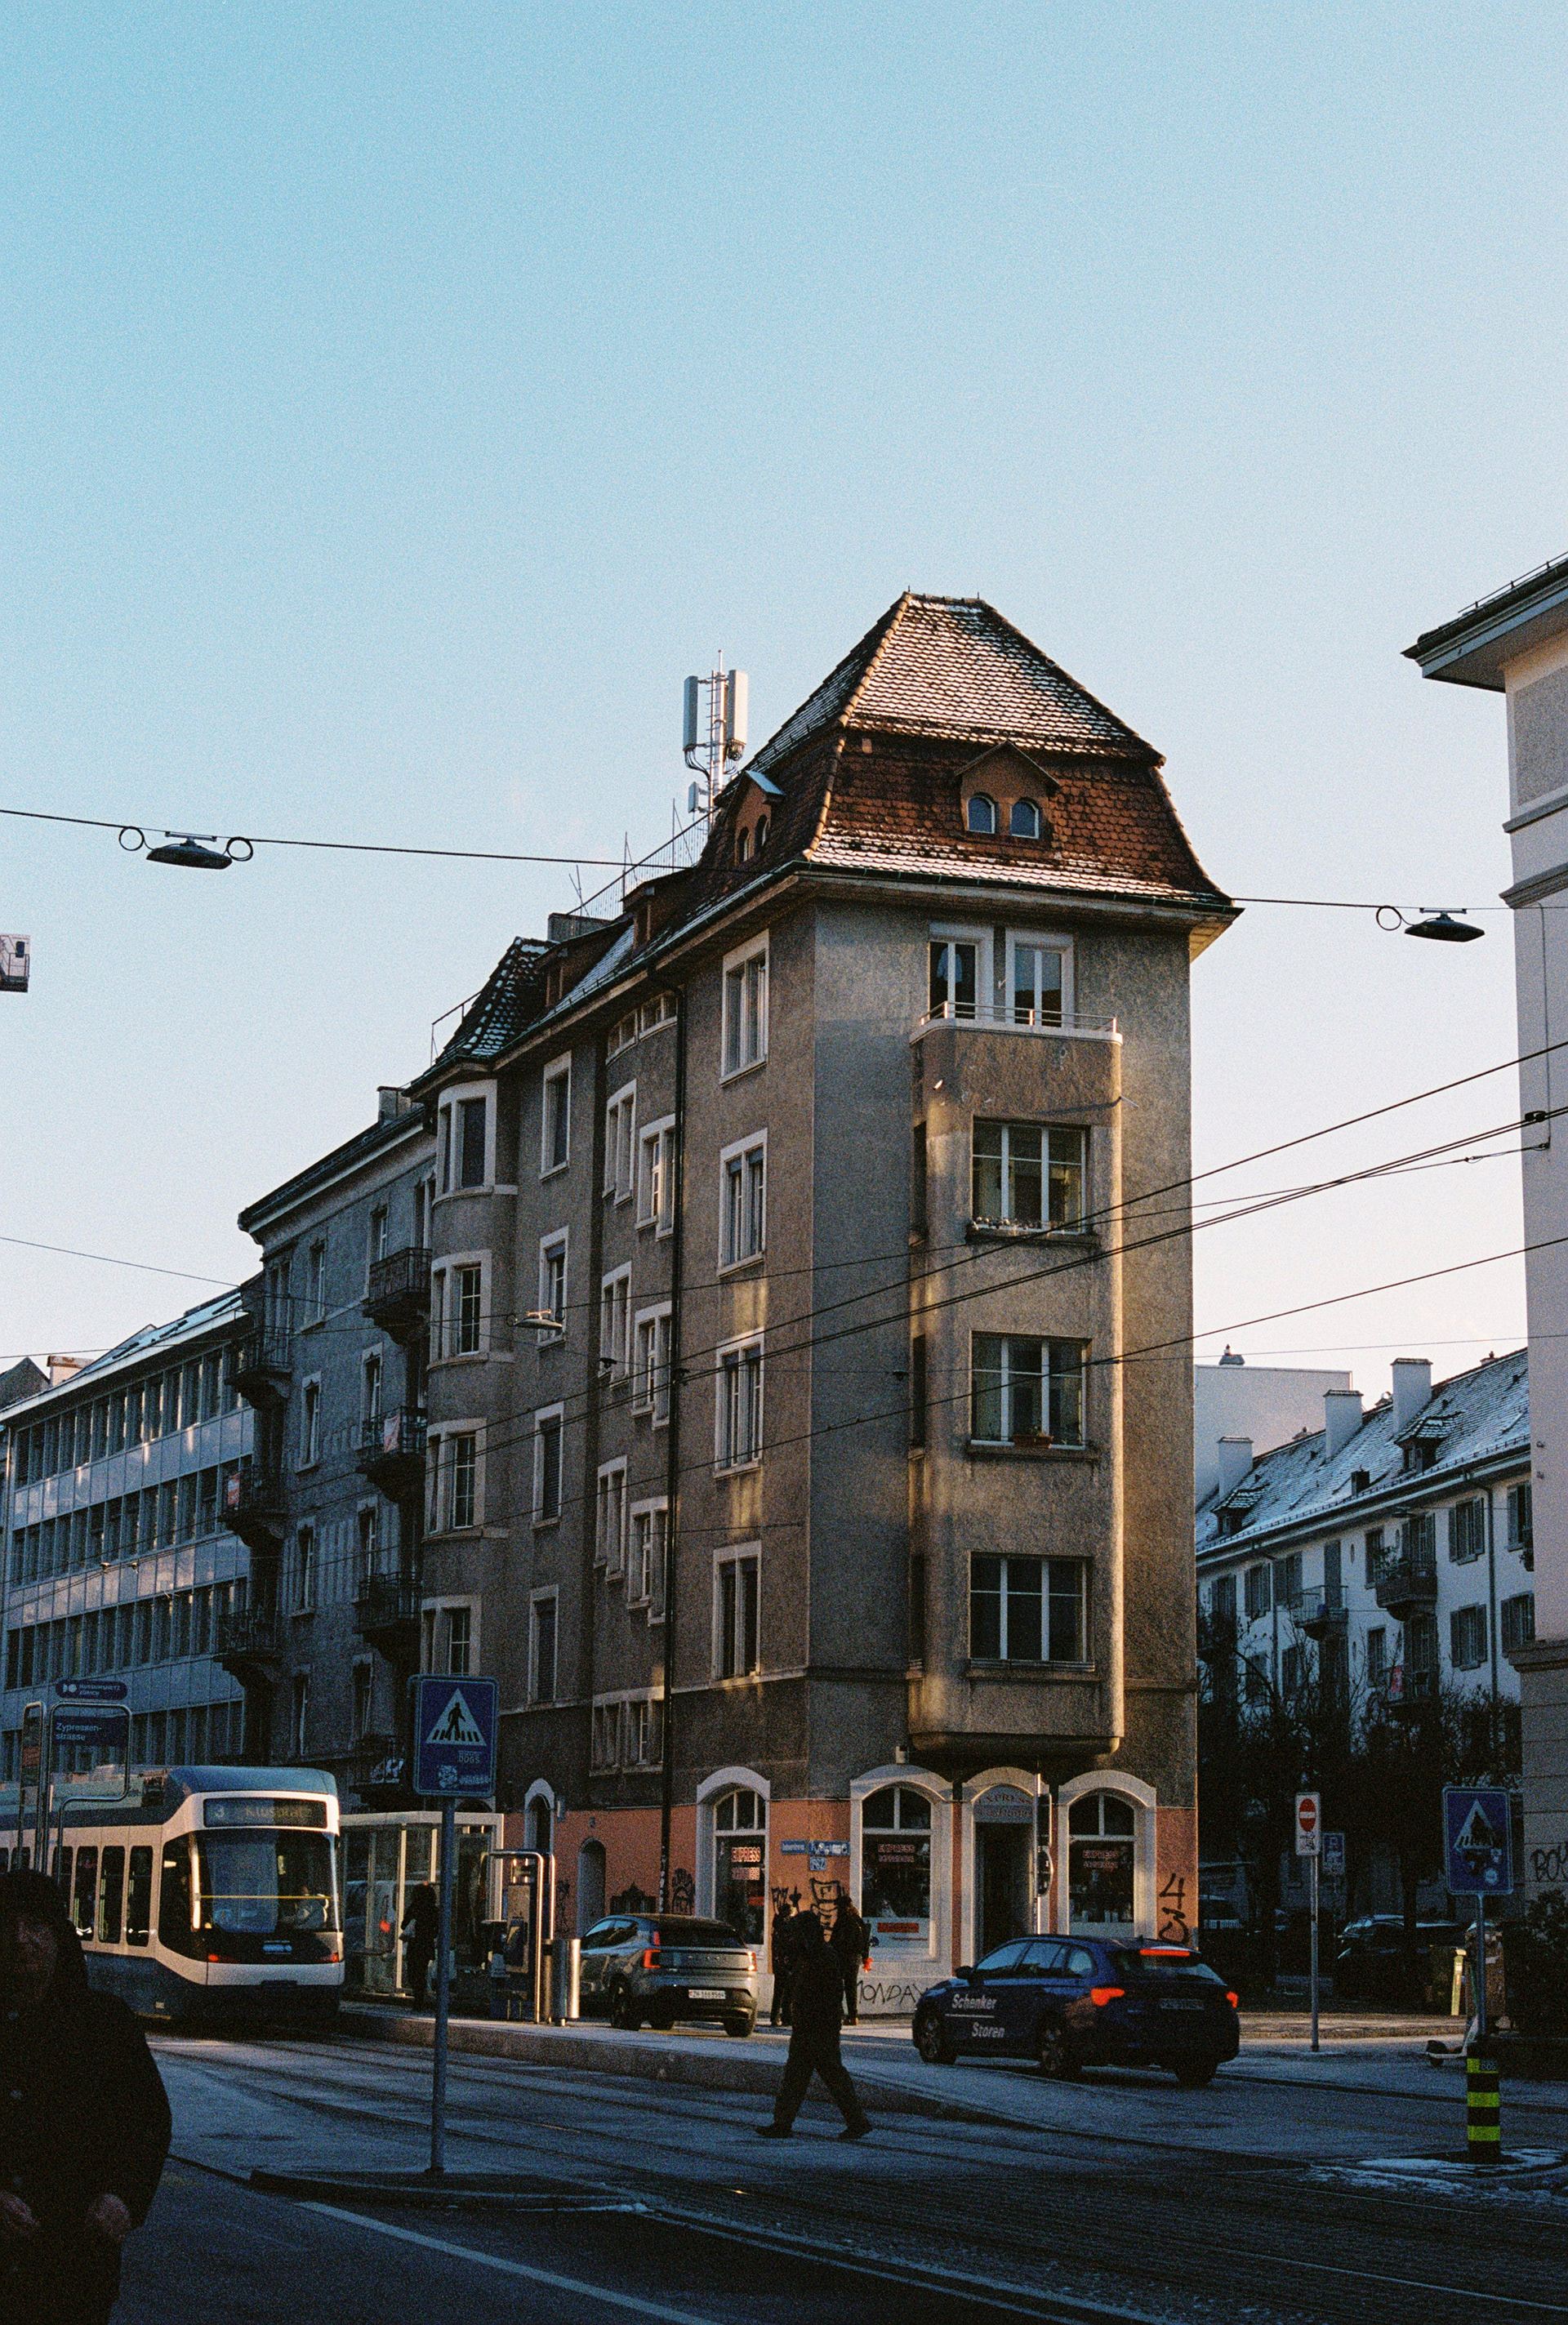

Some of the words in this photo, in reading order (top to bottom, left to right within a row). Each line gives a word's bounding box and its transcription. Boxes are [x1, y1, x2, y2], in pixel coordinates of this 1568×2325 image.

[56, 1722, 102, 1732] Zypressen-
[214, 1805, 226, 1819] 3
[731, 1846, 761, 1862] EXPRESS
[878, 1843, 915, 1853] EXPRESS
[1082, 1850, 1120, 1860] EXPRESS
[951, 1993, 998, 2010] Schenker
[971, 2021, 1006, 2038] Storen
